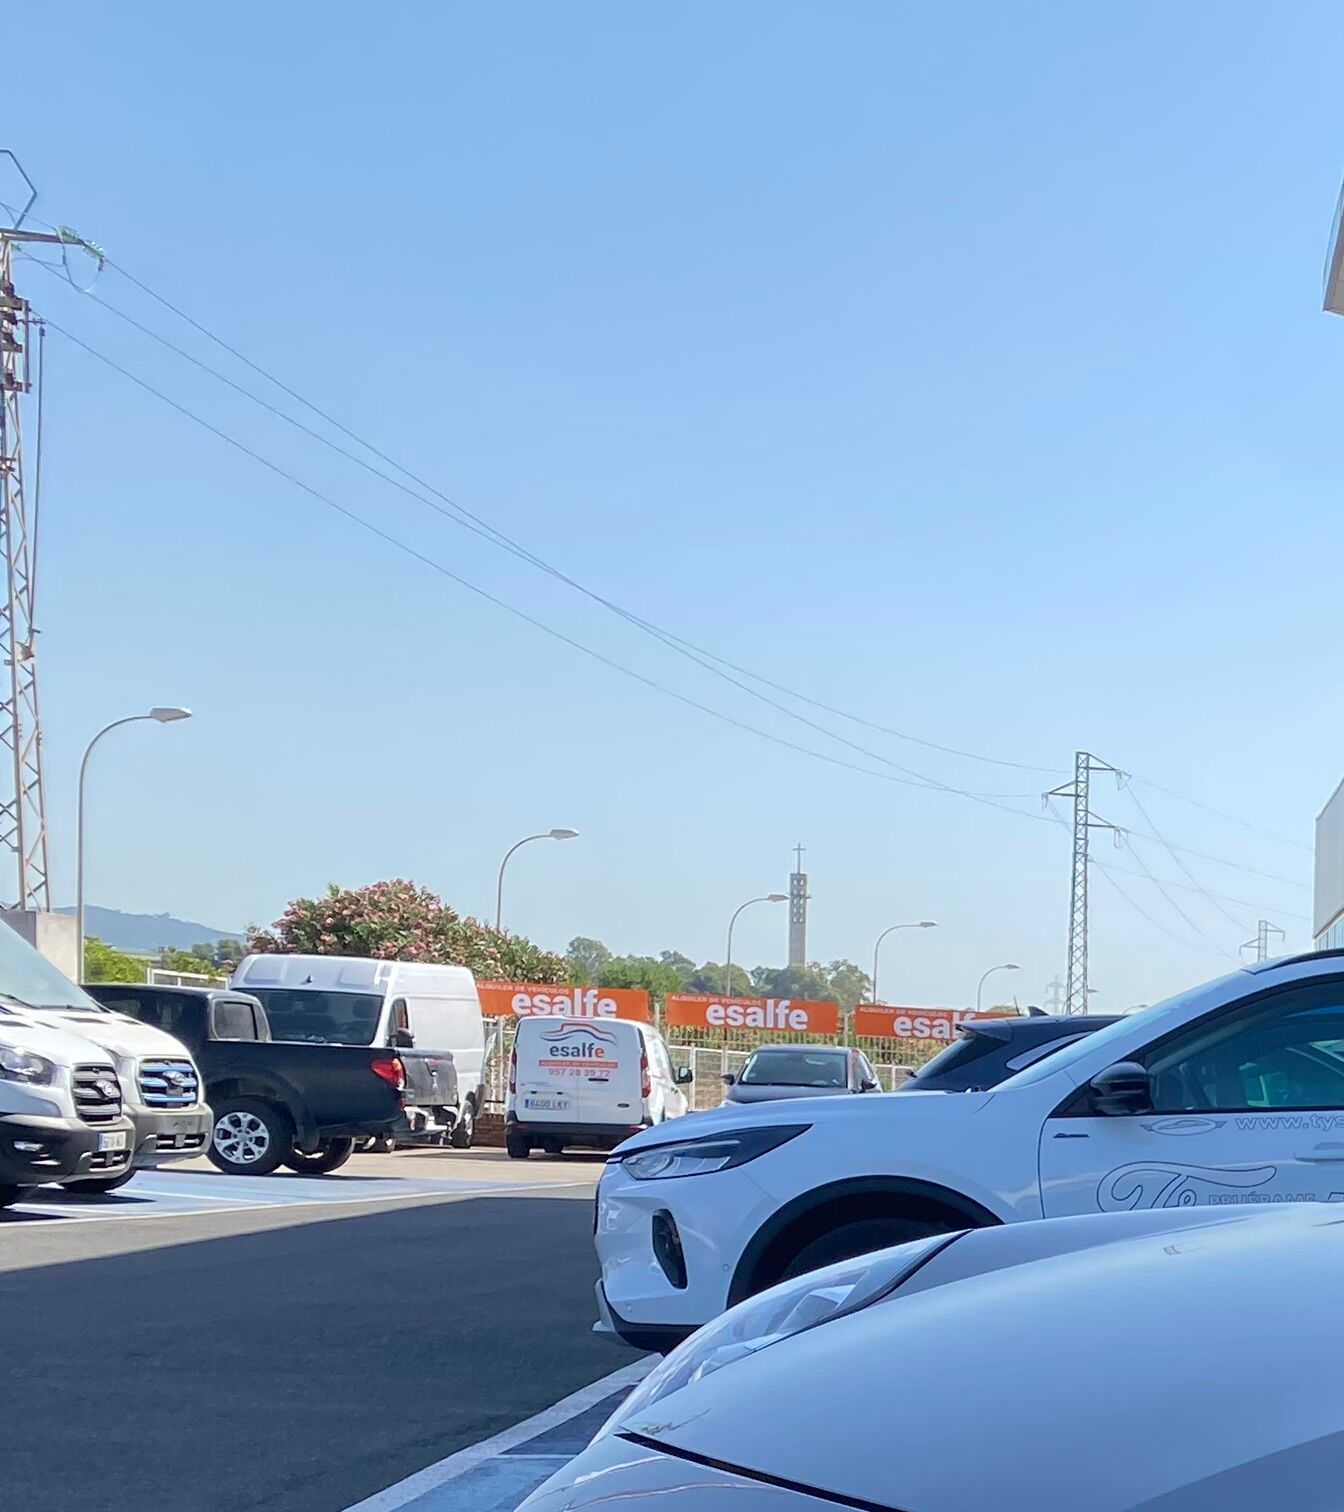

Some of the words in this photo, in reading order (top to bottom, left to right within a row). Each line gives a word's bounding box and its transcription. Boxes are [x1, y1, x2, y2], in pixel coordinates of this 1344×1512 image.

[511, 988, 617, 1018] esalfe
[705, 1000, 808, 1030] esalfe
[550, 1043, 605, 1059] esalfe
